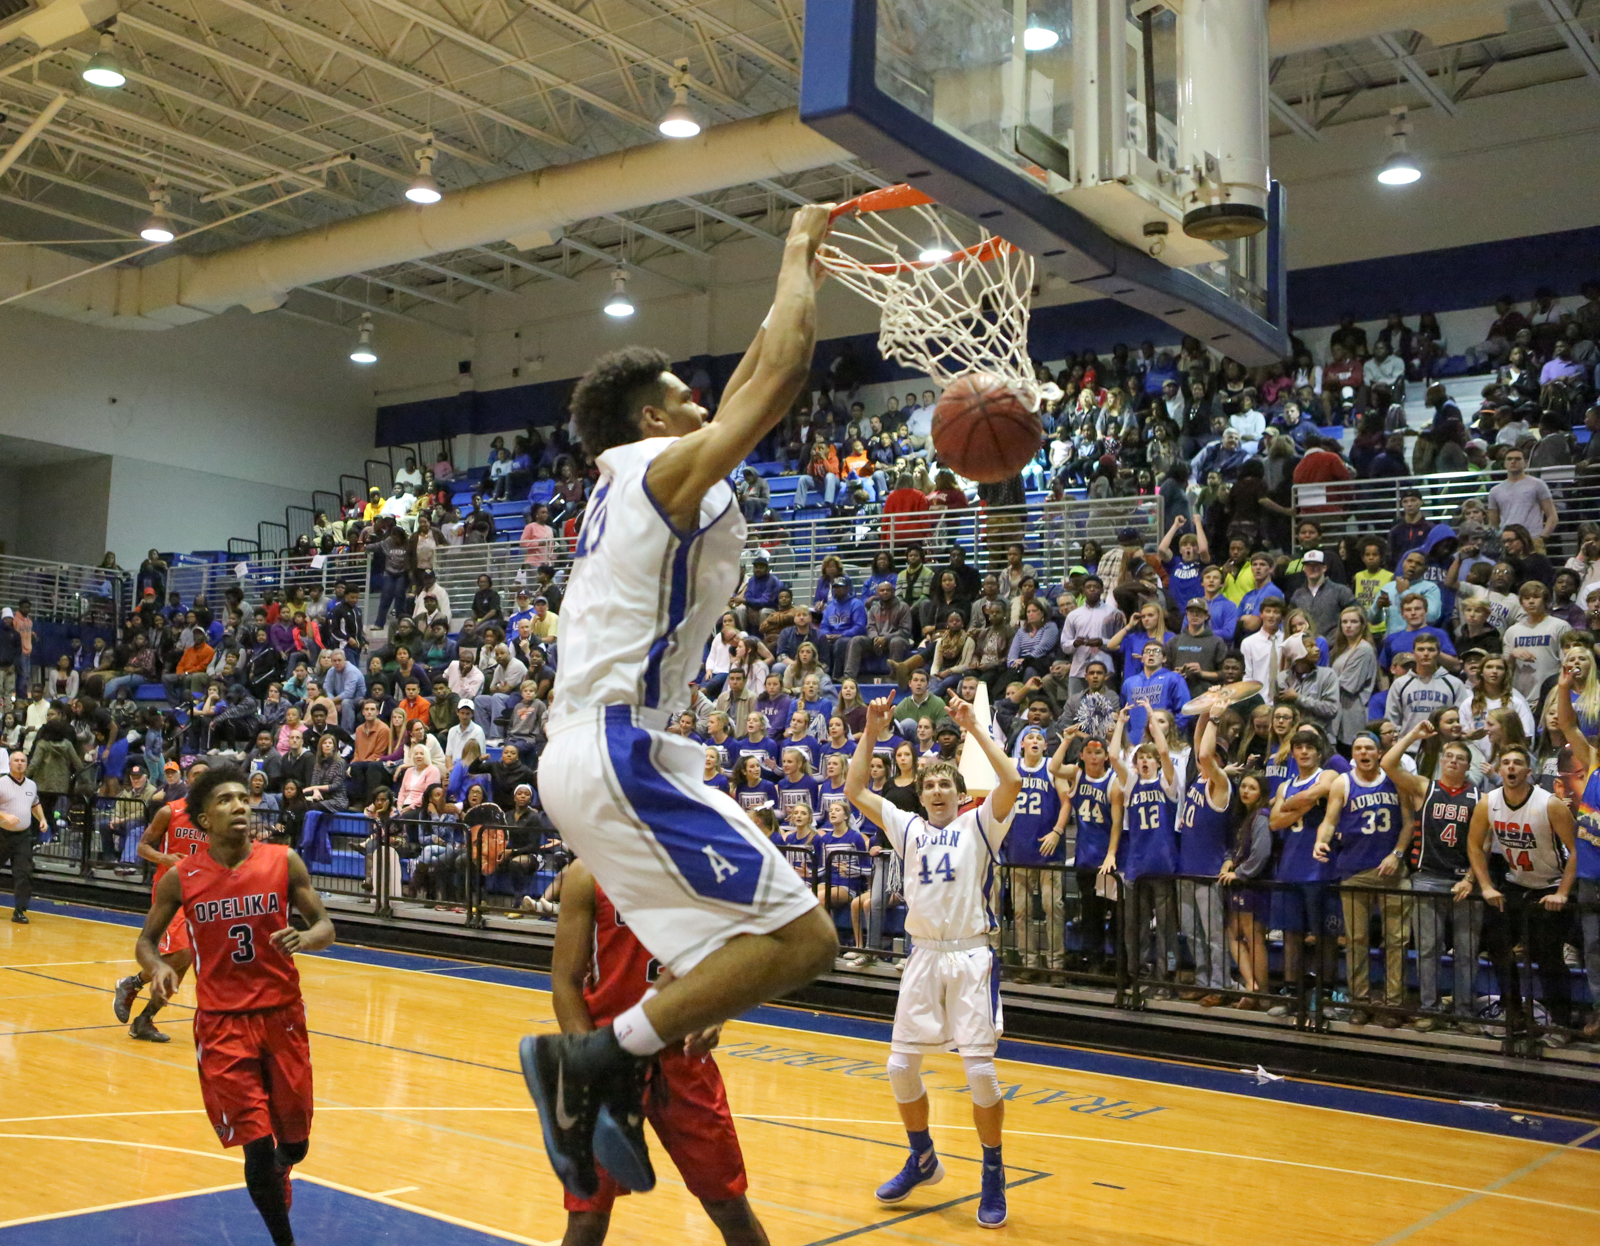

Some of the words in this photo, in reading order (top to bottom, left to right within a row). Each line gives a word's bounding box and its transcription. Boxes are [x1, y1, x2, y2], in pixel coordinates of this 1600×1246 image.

[1407, 690, 1448, 706] AUBURN
[1411, 705, 1434, 713] BASEBA
[1015, 791, 1042, 815] 22
[1078, 799, 1104, 823] 44
[1350, 792, 1399, 813] AUBURN
[1432, 803, 1469, 823] USA
[1138, 805, 1160, 830] 12
[1361, 808, 1391, 834] 33
[175, 827, 209, 841] OPELIK
[1440, 823, 1457, 848] 4
[1494, 820, 1536, 841] USA
[701, 844, 739, 884] A
[1506, 848, 1535, 872] 14
[194, 892, 280, 923] OPELIKA
[228, 924, 255, 964] 3
